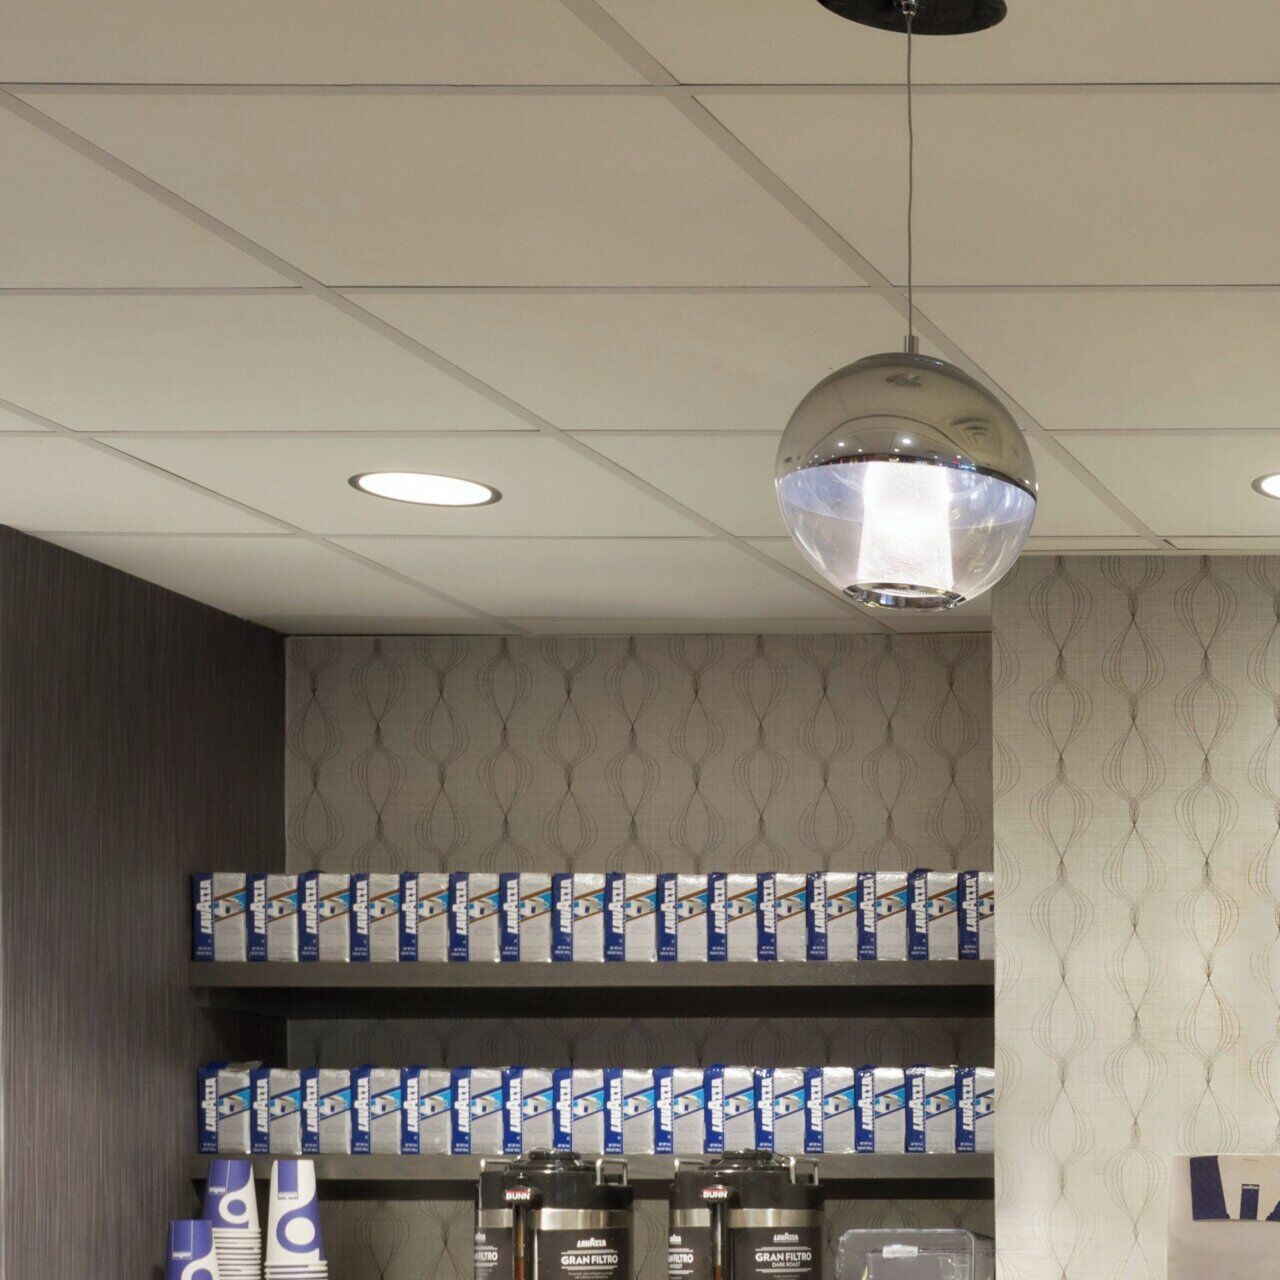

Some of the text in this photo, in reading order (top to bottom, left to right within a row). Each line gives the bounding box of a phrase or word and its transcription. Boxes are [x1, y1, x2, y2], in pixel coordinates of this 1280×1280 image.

[505, 1191, 531, 1201] BUNN
[702, 1189, 728, 1199] BUNN
[560, 1255, 619, 1265] GRAN FILTRO
[755, 1251, 812, 1262] GRAN FILTRO
